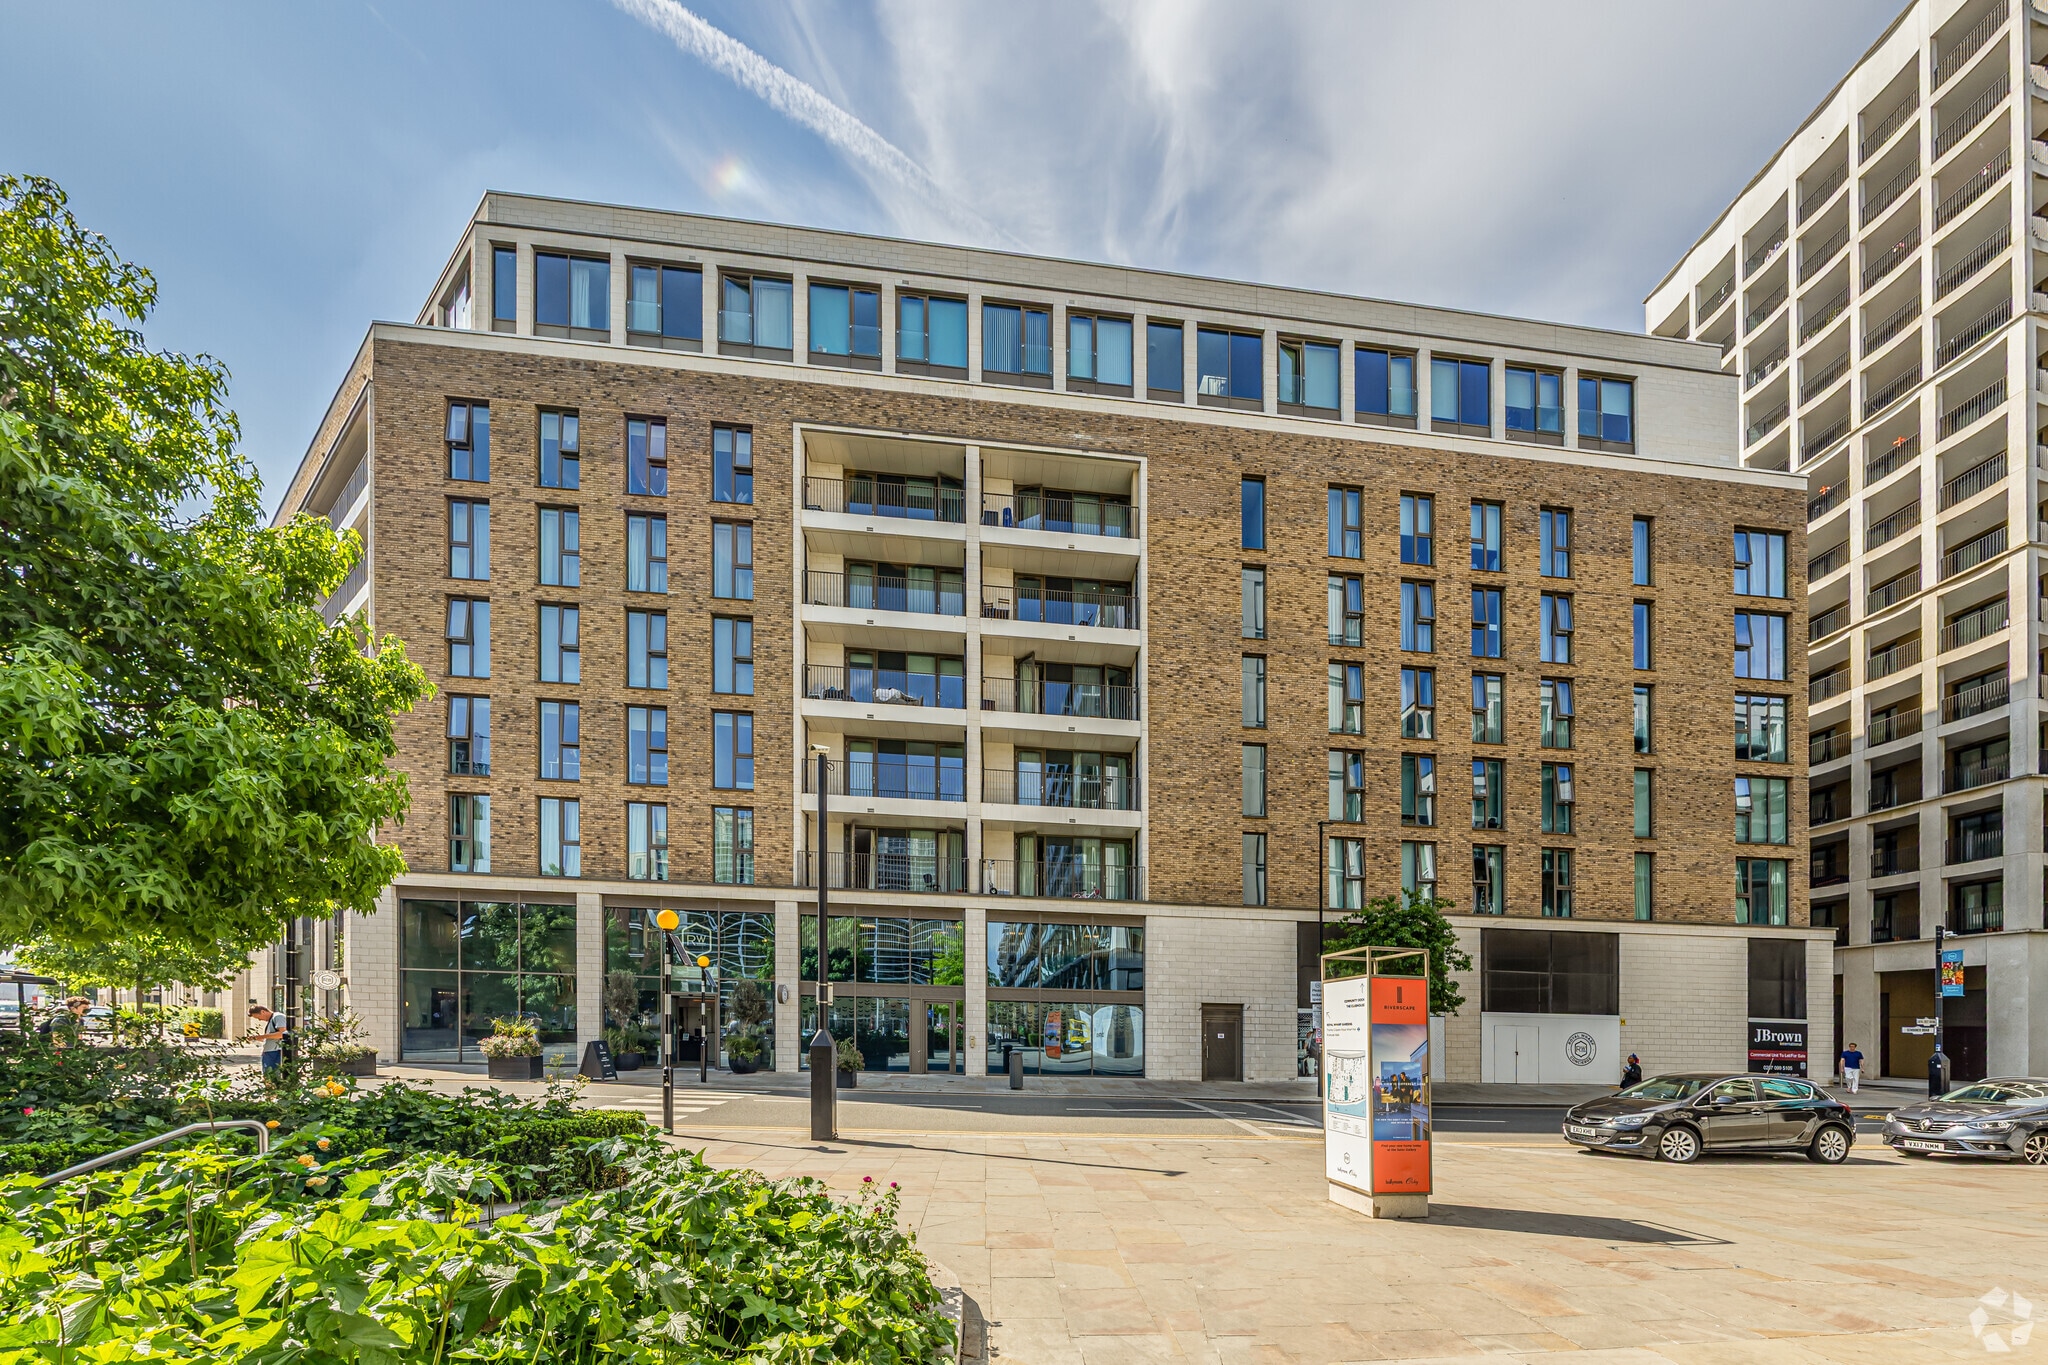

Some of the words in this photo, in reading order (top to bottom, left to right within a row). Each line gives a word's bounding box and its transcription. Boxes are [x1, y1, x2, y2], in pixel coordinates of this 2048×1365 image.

[686, 934, 707, 946] RW
[1754, 1028, 1802, 1043] JBrown
[1570, 1055, 1592, 1064] CONCIERGE
